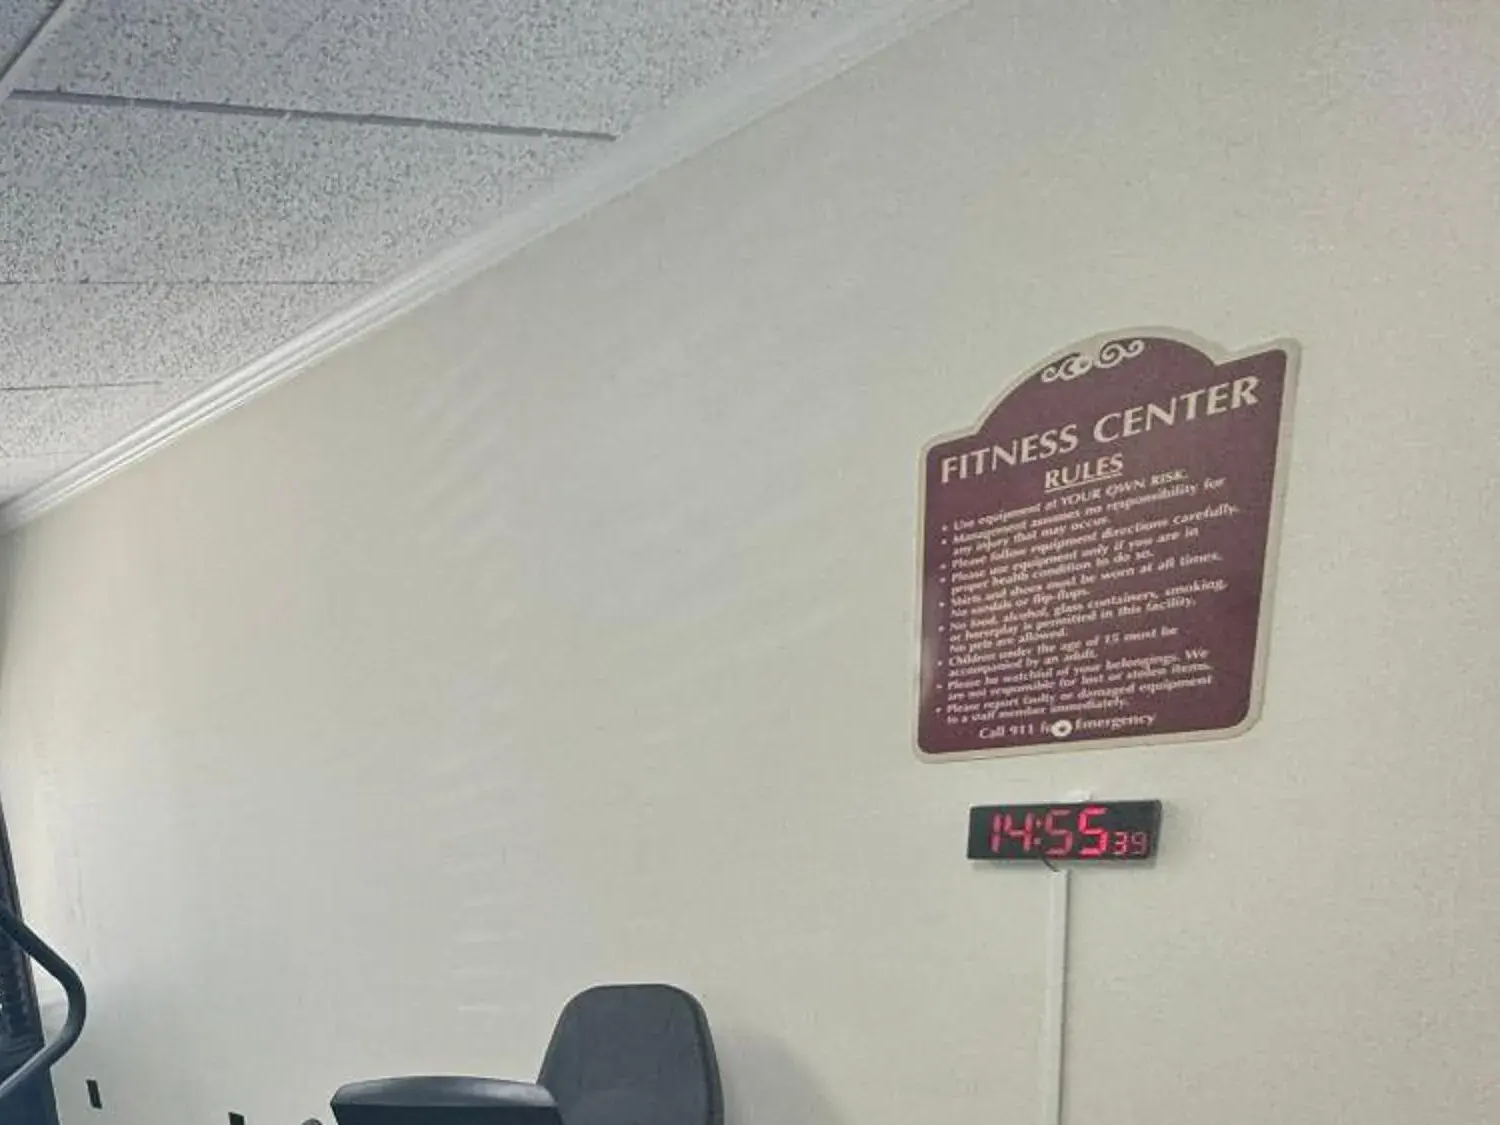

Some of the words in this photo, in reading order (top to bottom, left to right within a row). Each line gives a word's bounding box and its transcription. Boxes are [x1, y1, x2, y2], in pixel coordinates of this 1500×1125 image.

[940, 423, 1079, 483] FITNESS
[1092, 375, 1261, 444] CENTER
[1044, 452, 1124, 489] RULES
[991, 806, 1108, 856] 14:55
